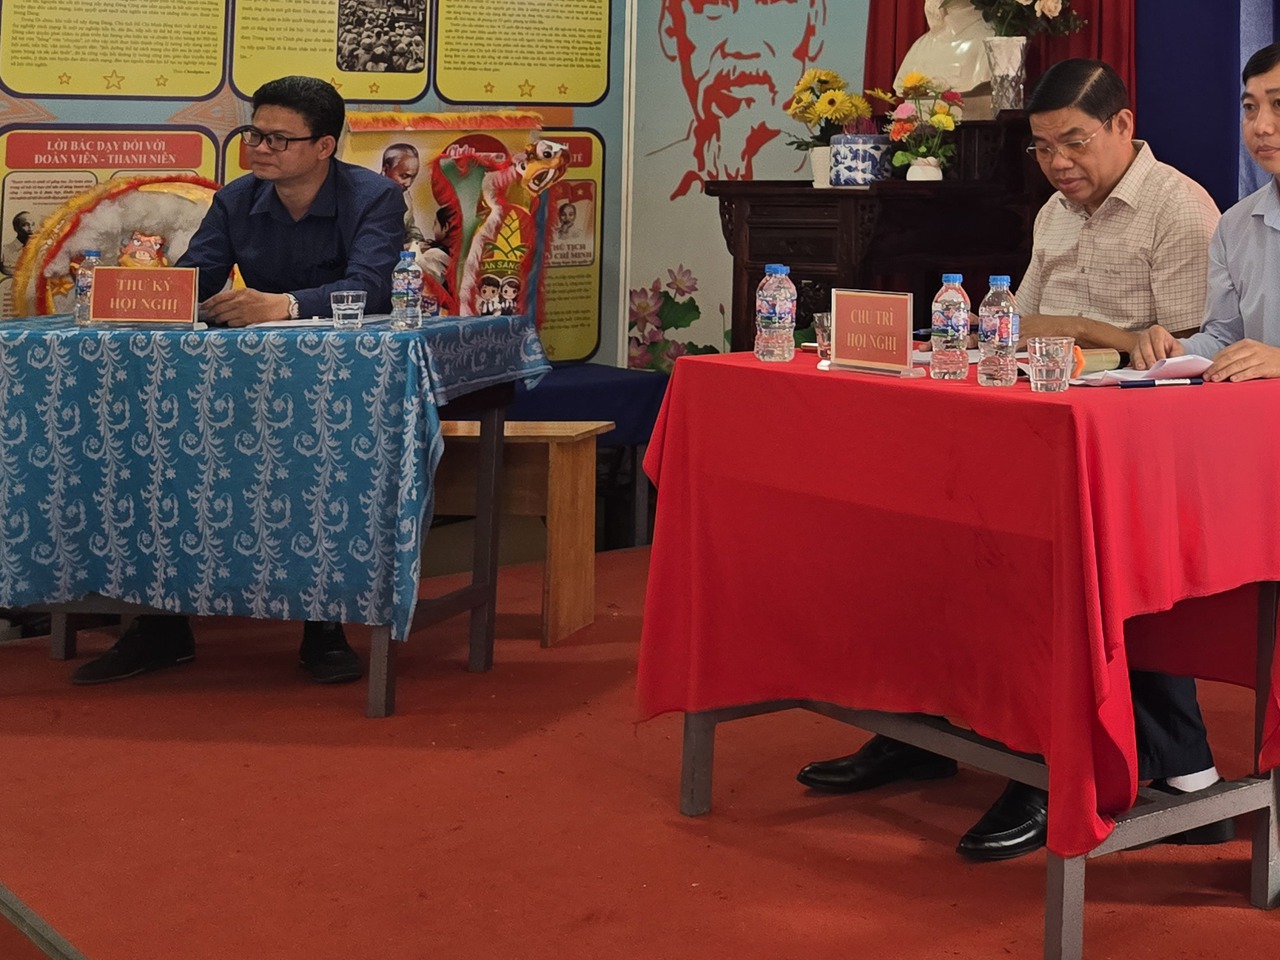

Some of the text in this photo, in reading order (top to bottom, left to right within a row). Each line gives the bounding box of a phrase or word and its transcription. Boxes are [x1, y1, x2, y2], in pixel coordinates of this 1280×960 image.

[47, 138, 166, 153] LỜI BÁC DẠY ĐỐI VỚI
[34, 152, 67, 164] ĐOÀN
[71, 152, 98, 164] VIÊN
[107, 153, 147, 164] THANH
[150, 152, 176, 164] NIÊN
[117, 277, 173, 291] THƯ KÝ
[141, 298, 178, 313] NGHỊ
[869, 334, 897, 355] NGHỊ
